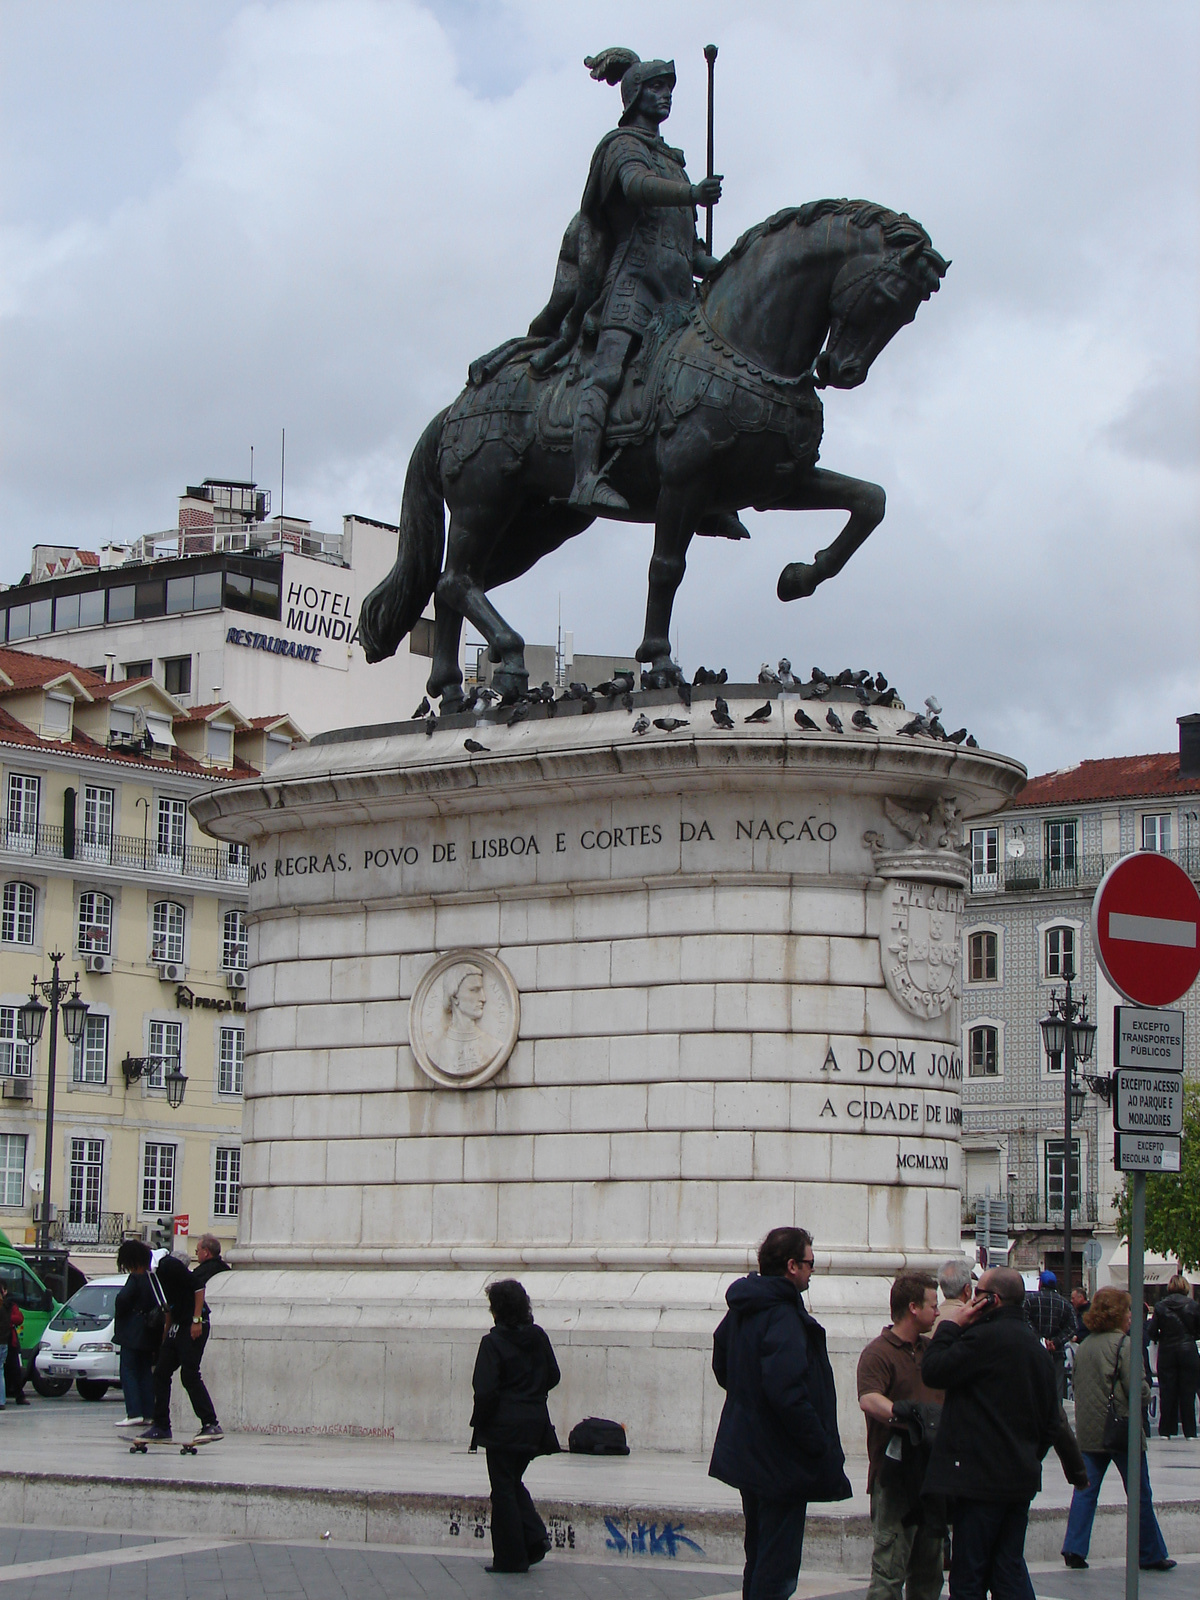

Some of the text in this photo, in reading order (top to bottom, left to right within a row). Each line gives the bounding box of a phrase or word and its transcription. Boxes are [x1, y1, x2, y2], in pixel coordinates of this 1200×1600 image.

[287, 582, 352, 619] HOTEL
[226, 627, 322, 663] RESTAURANTE
[250, 815, 837, 883] DAS REGRAS, POVO DE LISBOA E CORTES DA NAÇÃO
[195, 997, 232, 1012] PRAÇA
[1132, 1020, 1170, 1033] EXCEPTO
[1122, 1032, 1181, 1046] TRANSPORTES
[1130, 1044, 1171, 1057] PÚBLICOS
[820, 1046, 841, 1071] A
[857, 1048, 916, 1075] DOM
[1121, 1078, 1180, 1093] EXCEPTO ACESSO
[1127, 1094, 1173, 1111] AO PARQUE E
[819, 1098, 838, 1117] A
[846, 1100, 919, 1121] CIDADE
[925, 1104, 942, 1123] DE
[1128, 1112, 1172, 1127] MORADORES
[1137, 1141, 1165, 1151] EXCEPTO
[896, 1154, 949, 1170] MCMLXXI
[1122, 1153, 1150, 1164] RECOLHA
